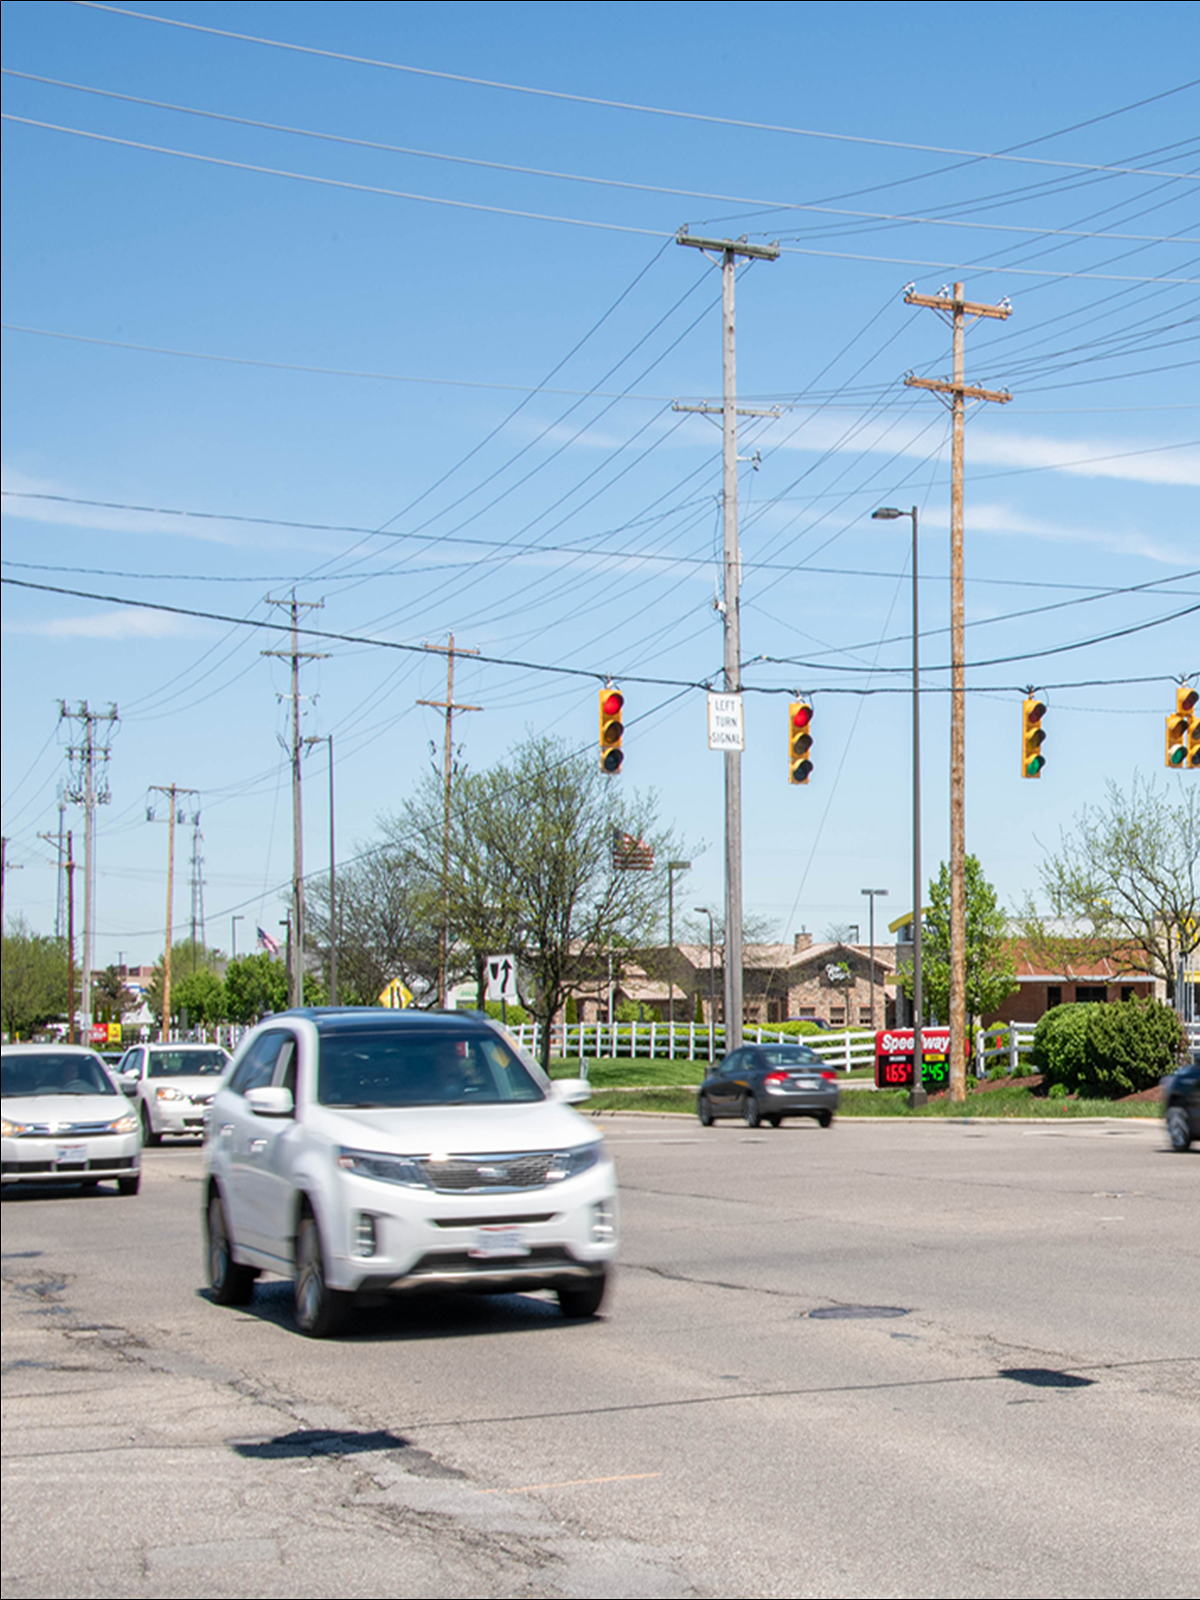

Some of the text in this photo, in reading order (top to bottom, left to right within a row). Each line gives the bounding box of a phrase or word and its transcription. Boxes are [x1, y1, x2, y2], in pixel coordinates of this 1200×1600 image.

[715, 700, 735, 711] LEFT
[715, 715, 738, 727] TURN
[711, 732, 741, 744] SIGNAL
[882, 1034, 950, 1053] Speeway
